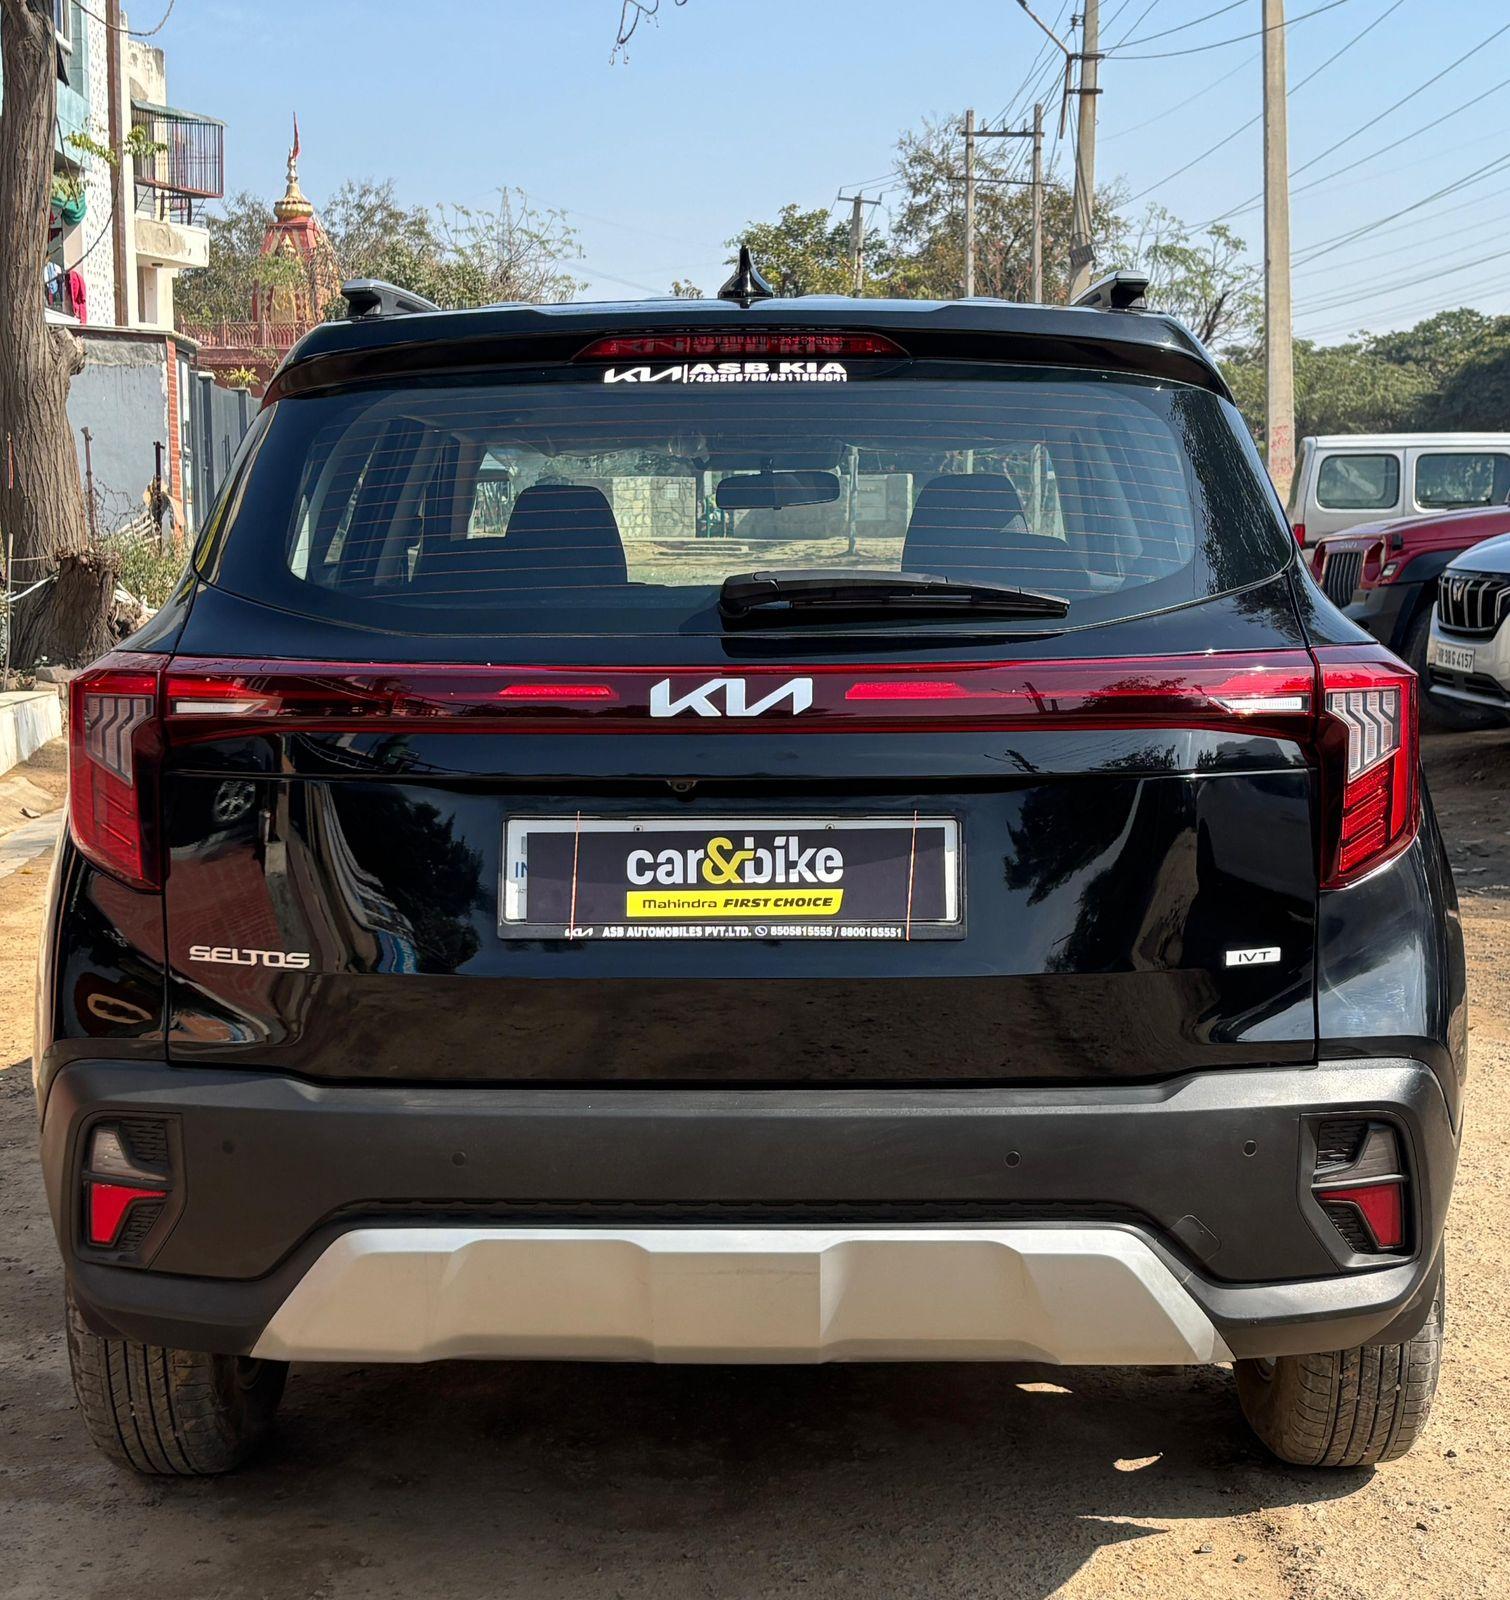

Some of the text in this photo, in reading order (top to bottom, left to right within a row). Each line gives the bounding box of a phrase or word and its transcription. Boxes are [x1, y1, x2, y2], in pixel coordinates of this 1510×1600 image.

[689, 362, 847, 375] ASB KIA
[650, 677, 813, 717] KIA
[626, 835, 844, 885] car&bike
[642, 897, 833, 909] Mahindra FIRST CHOICE
[602, 926, 624, 938] ASB
[626, 926, 703, 938] AUTOMOBILES
[189, 945, 310, 969] SELTOS
[1238, 950, 1271, 963] IVT
